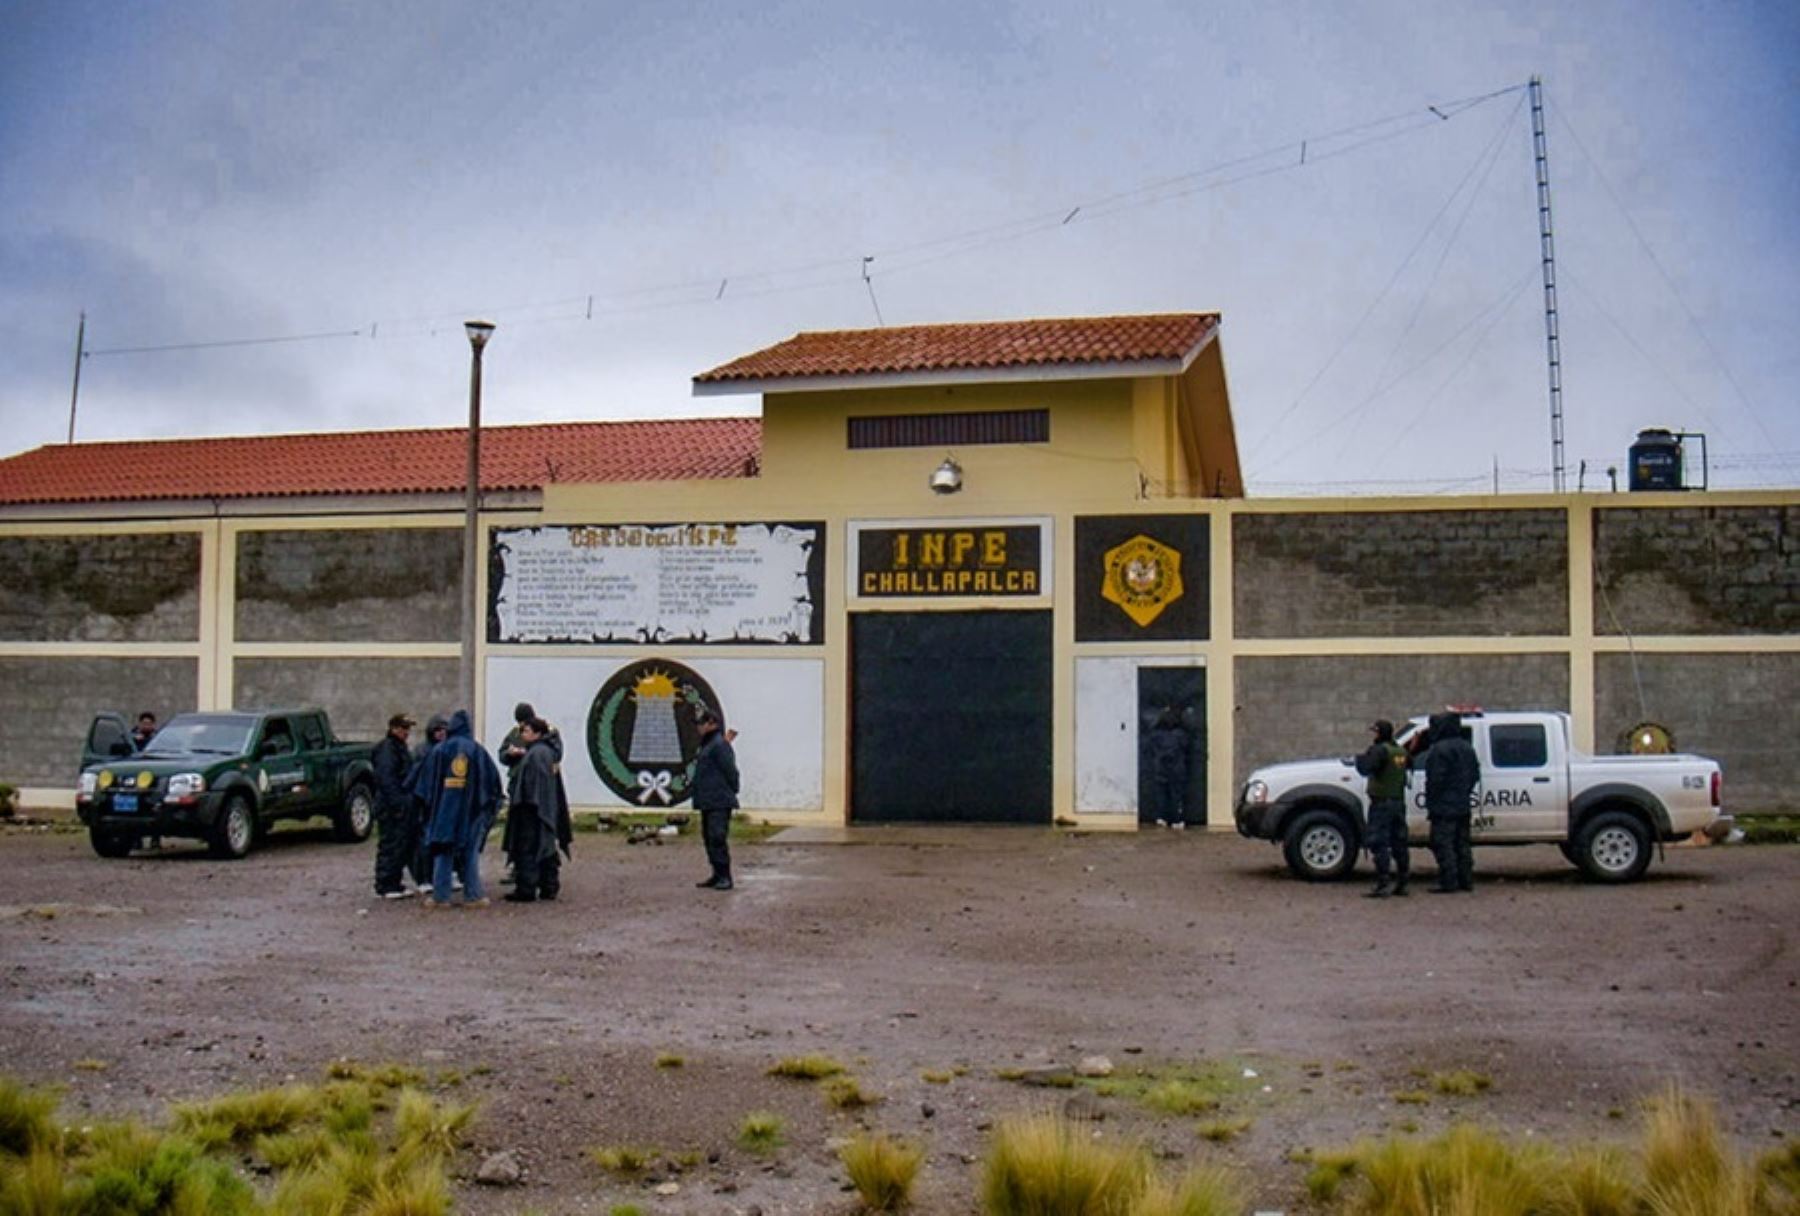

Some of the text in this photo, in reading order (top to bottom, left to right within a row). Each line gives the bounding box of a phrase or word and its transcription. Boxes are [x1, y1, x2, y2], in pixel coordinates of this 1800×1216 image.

[893, 532, 1006, 566] INPE
[863, 570, 1036, 593] CHALLAPALCA
[1415, 789, 1532, 809] CSARIA
